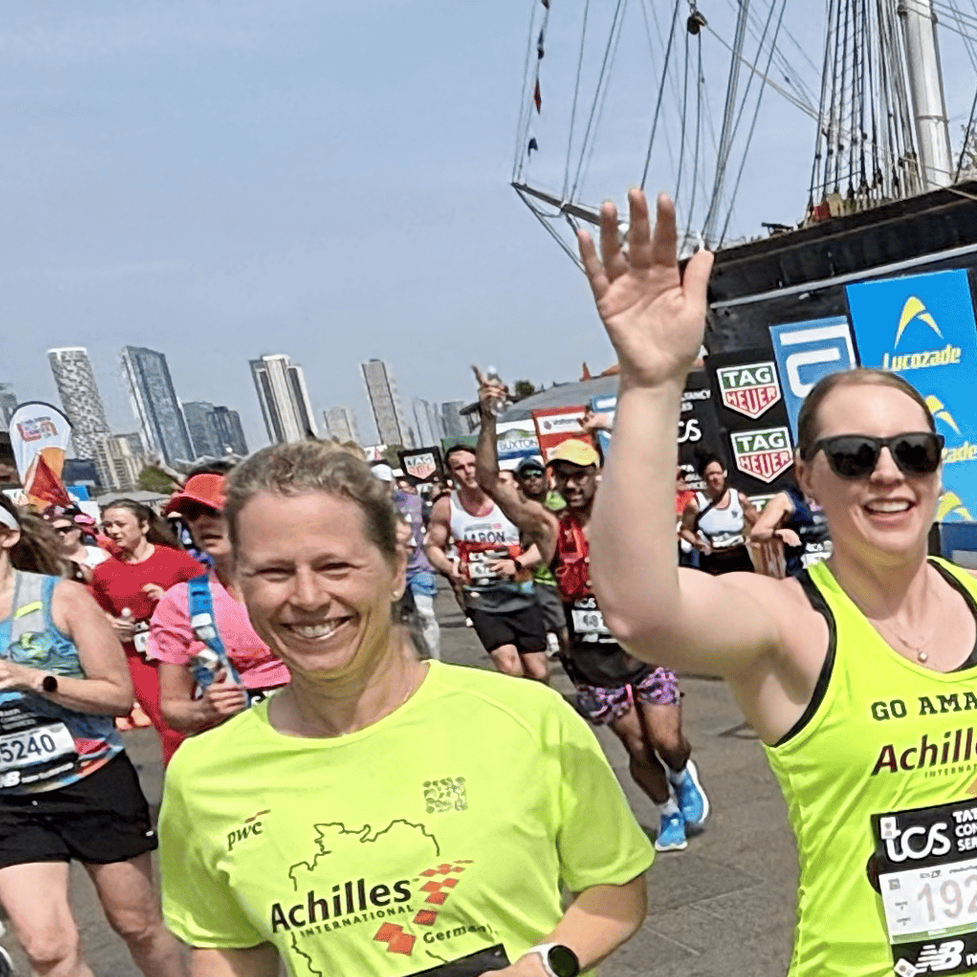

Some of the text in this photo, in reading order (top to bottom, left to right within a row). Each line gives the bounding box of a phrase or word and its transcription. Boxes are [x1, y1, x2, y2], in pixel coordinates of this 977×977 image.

[883, 343, 961, 371] Lucozade
[723, 367, 772, 388] TAG
[725, 385, 777, 414] HEUER
[737, 432, 785, 452] TAG
[739, 450, 791, 479] HEUER
[871, 699, 907, 721] GO
[227, 821, 263, 851] pwc
[885, 820, 951, 862] tcs
[271, 878, 412, 933] Achilles
[300, 904, 415, 938] INTERNATIONAL
